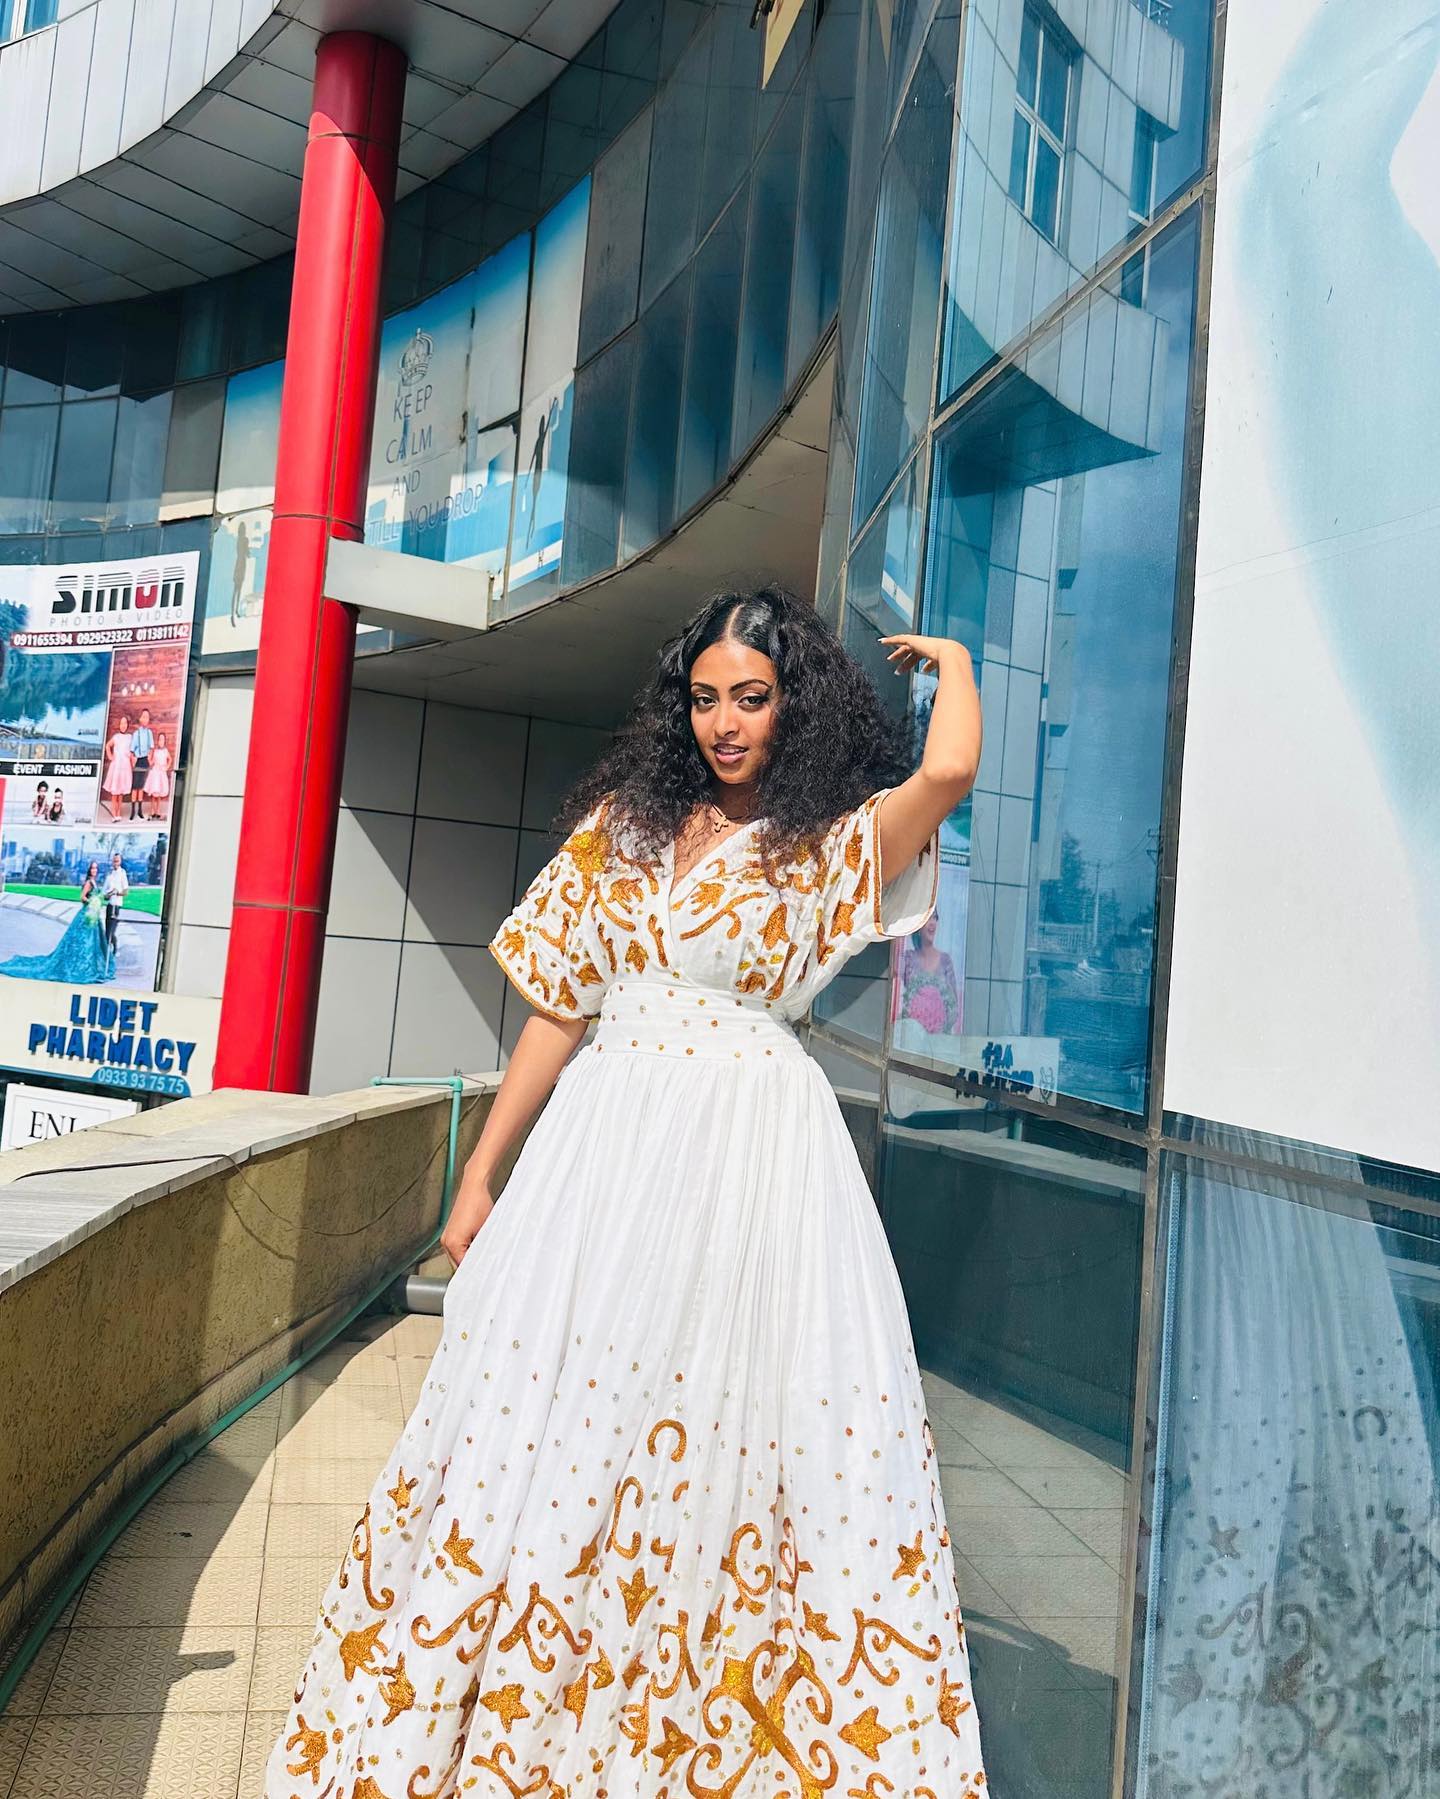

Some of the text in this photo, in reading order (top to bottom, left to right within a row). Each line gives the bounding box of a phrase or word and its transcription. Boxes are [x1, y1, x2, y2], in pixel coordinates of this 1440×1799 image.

[393, 384, 433, 423] KEEP
[386, 425, 433, 464] CALM
[392, 469, 421, 498] AND
[369, 484, 483, 543] TILL YOU DROP
[50, 615, 105, 627] PHOTO
[136, 608, 183, 622] VIDEO
[13, 763, 92, 776] EVENT FASHION
[69, 994, 159, 1033] LIDET
[28, 1023, 197, 1076] PHARMACY
[98, 1068, 184, 1094] 0933 93 75 75
